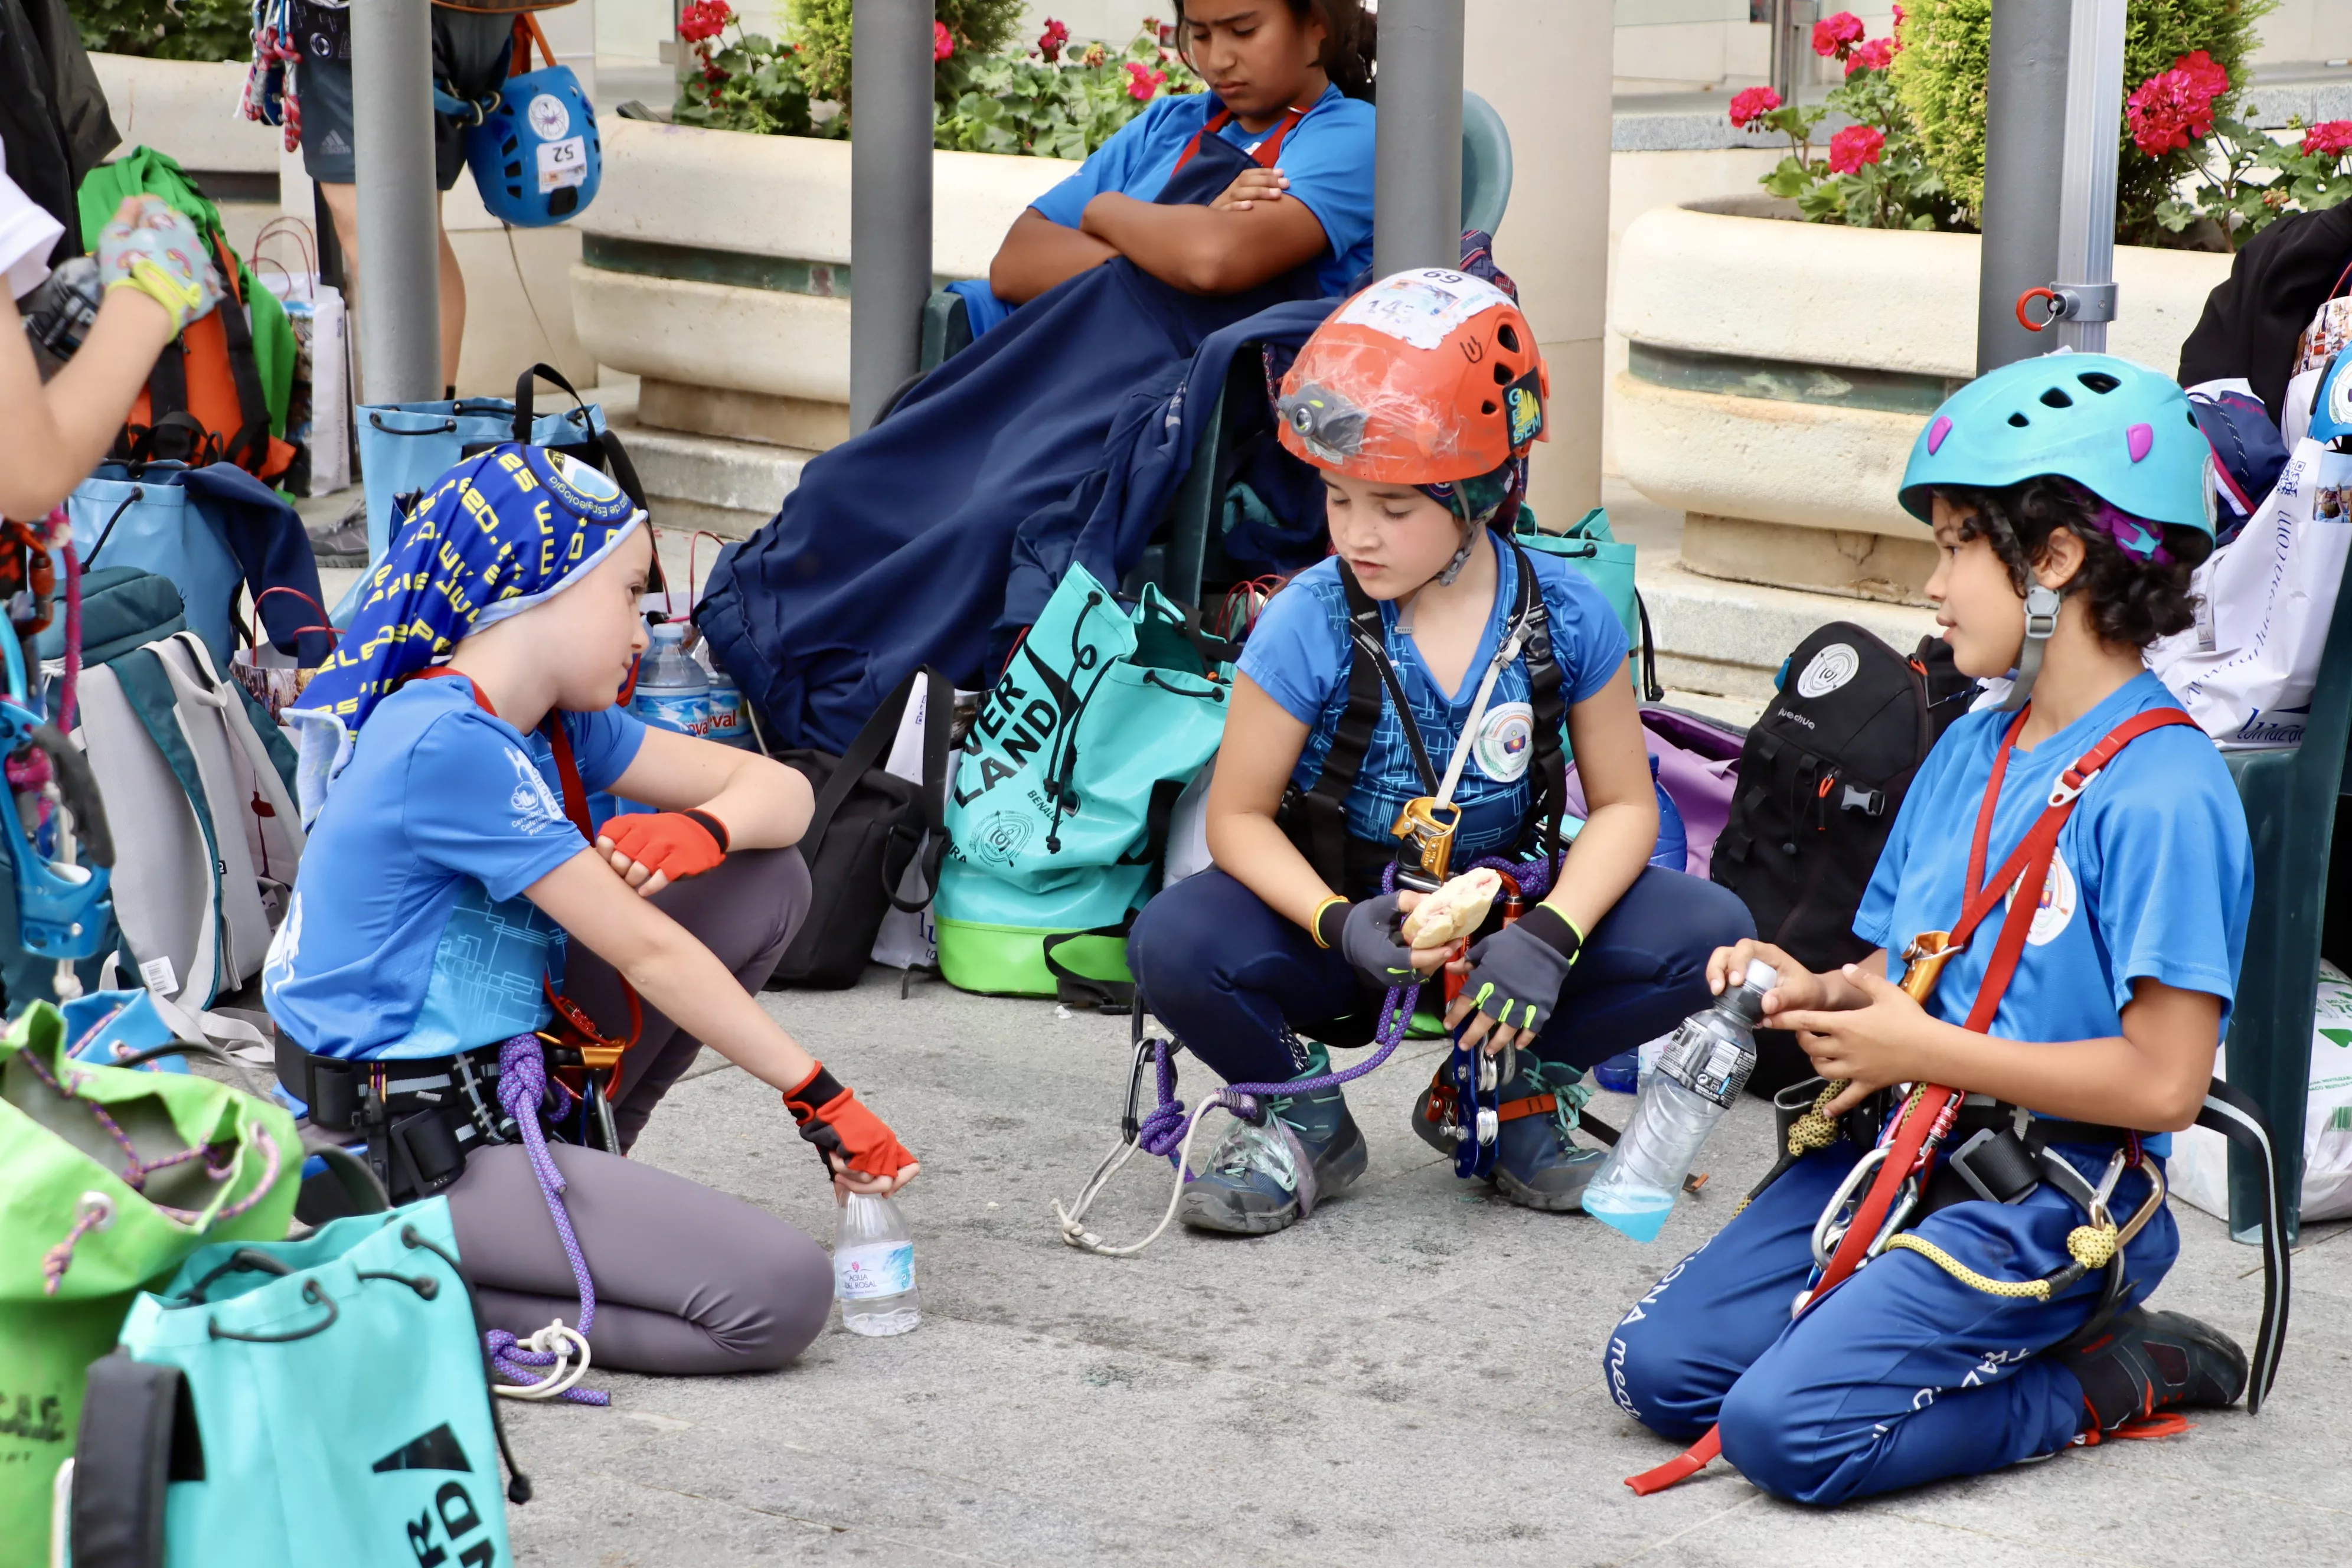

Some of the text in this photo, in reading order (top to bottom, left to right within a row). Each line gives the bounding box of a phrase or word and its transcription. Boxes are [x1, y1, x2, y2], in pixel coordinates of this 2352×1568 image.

[553, 144, 574, 163] 52
[1422, 270, 1463, 283] 69
[953, 698, 1057, 809] LAND
